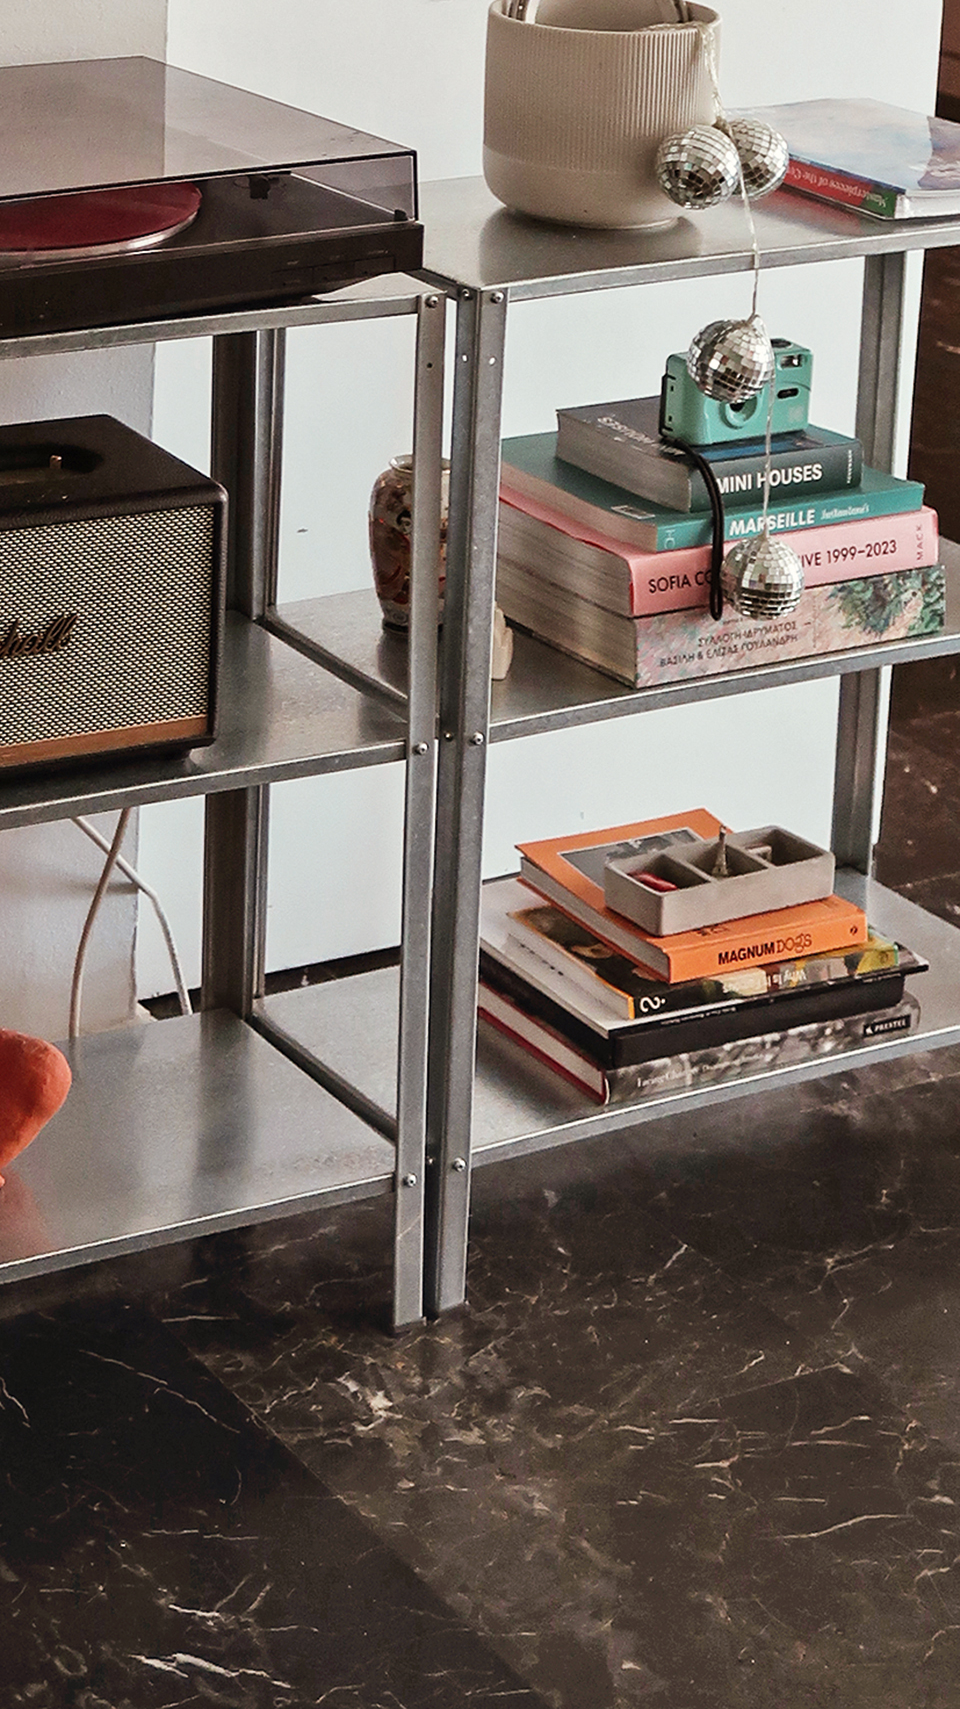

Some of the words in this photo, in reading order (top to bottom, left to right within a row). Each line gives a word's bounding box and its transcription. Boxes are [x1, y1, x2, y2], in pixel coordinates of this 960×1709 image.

[716, 473, 752, 495] MINI
[757, 463, 823, 488] HOUSES
[729, 509, 816, 537] MARSEILLE
[915, 523, 924, 561] MACK
[648, 573, 692, 594] SOFIA
[826, 539, 898, 565] 1999-2023
[718, 941, 775, 966] MAGNUM
